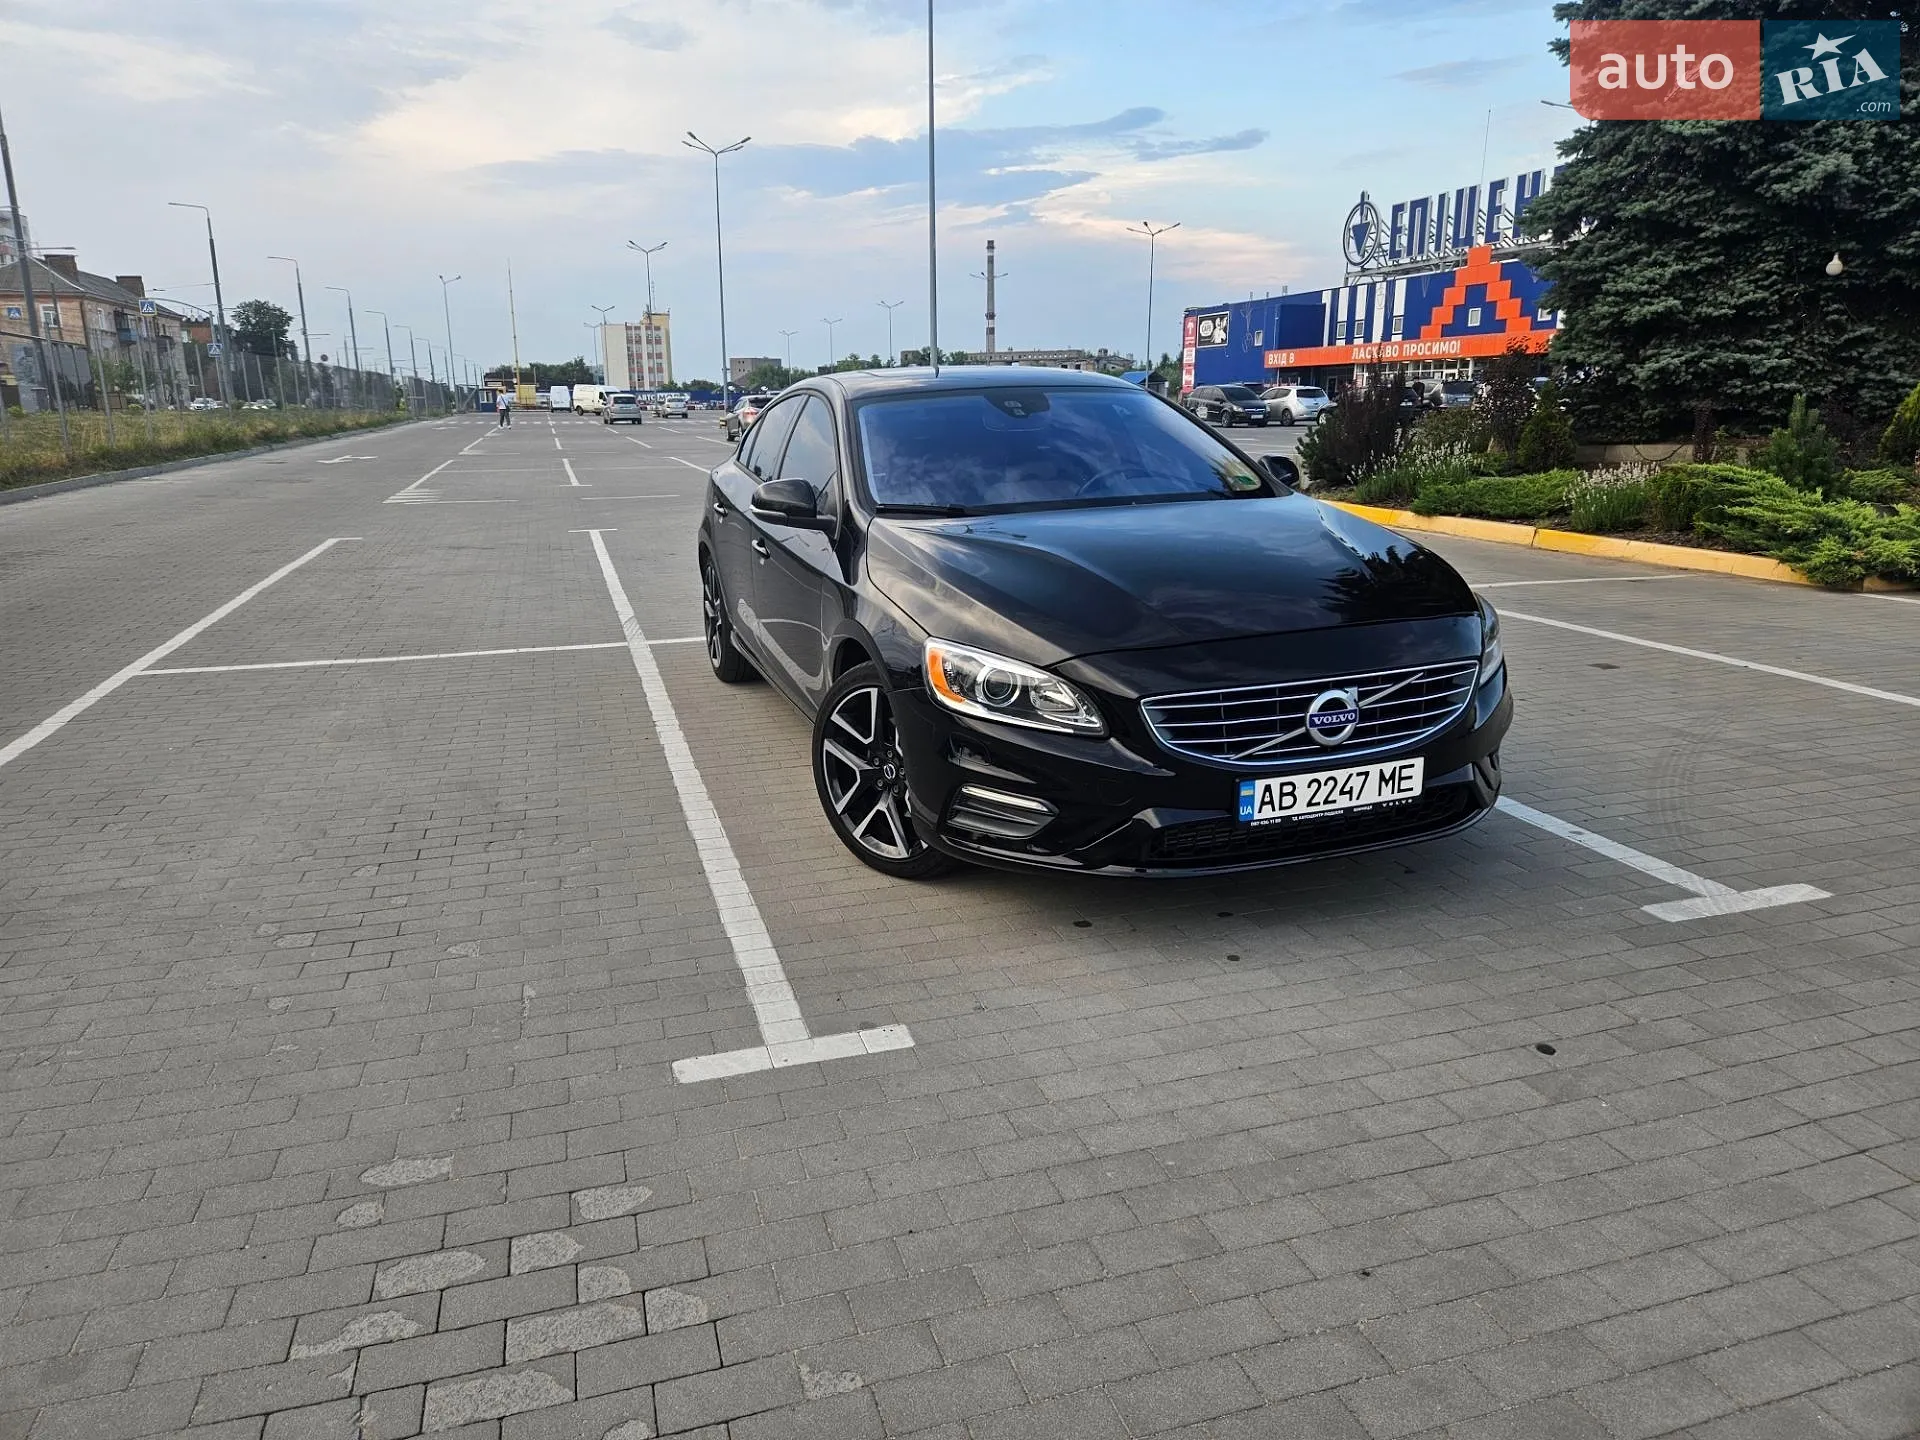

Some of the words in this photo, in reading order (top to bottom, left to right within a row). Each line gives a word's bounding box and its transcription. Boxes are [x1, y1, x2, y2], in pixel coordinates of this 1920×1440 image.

[1388, 164, 1567, 260] ЕПІЦЕН
[1268, 353, 1287, 366] ВХІД
[1403, 340, 1461, 357] ПРОСИМО!
[1312, 711, 1356, 725] VOLVO
[1257, 780, 1298, 814] AB
[1306, 771, 1371, 808] 2247
[1378, 763, 1415, 797] ME
[1240, 805, 1253, 816] UA
